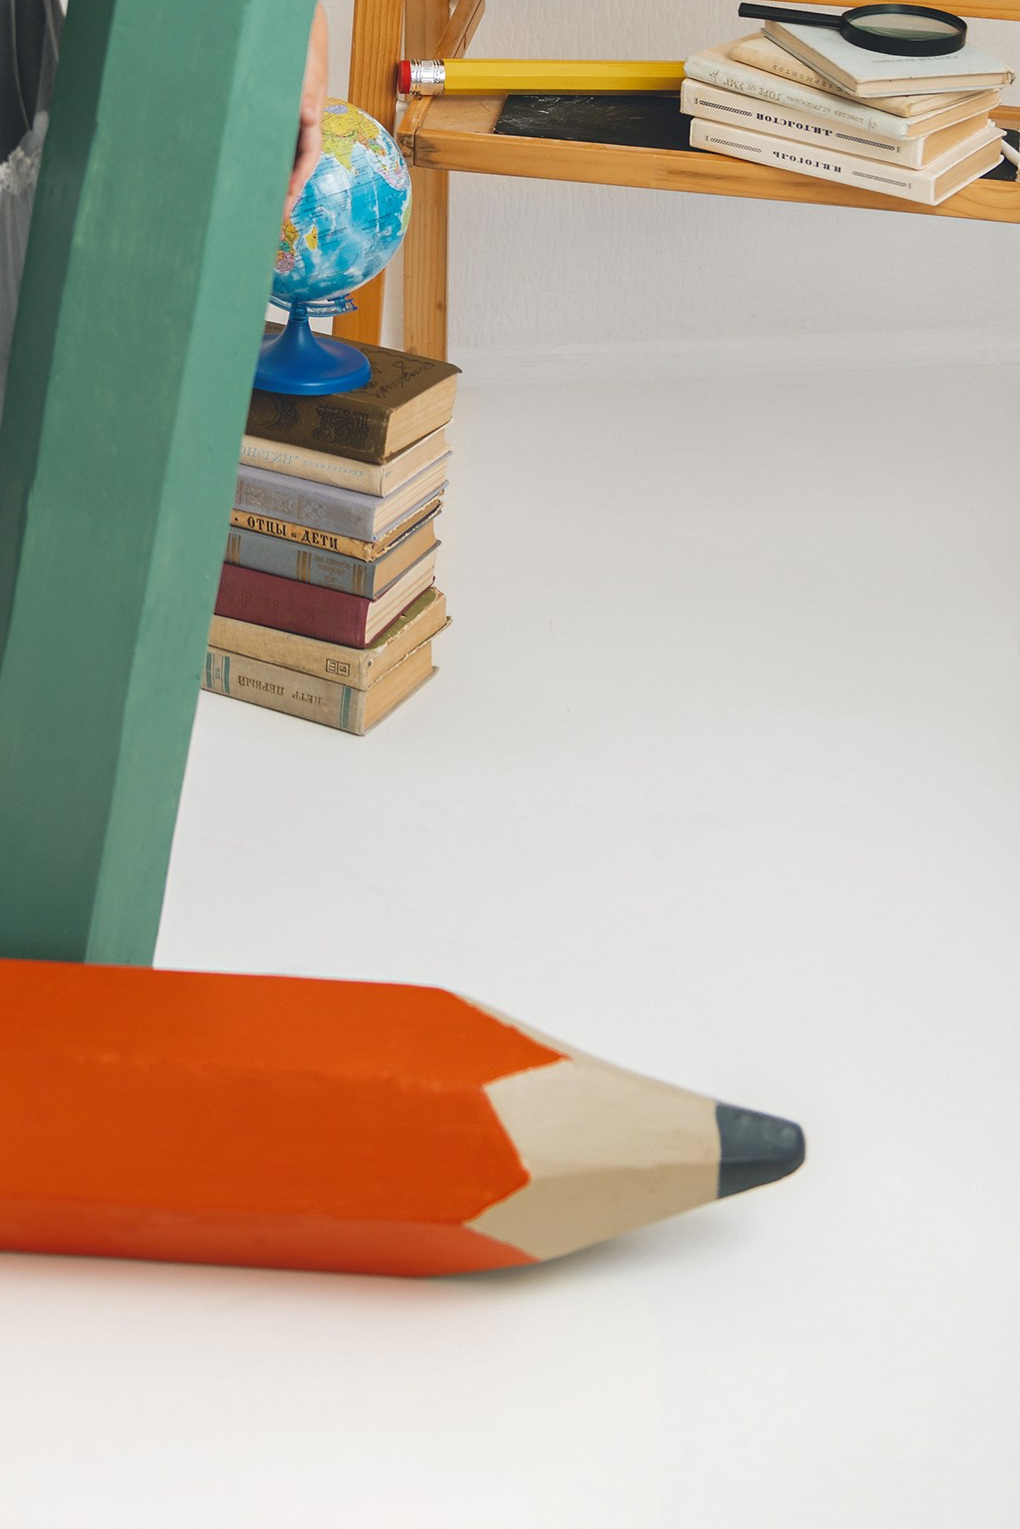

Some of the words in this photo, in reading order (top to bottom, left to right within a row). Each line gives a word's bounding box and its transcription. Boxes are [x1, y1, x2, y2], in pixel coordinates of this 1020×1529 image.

[247, 516, 287, 537] ОТЦЫ
[301, 530, 339, 550] ДЕТИ
[237, 675, 284, 696] ПЕРВЫЙ
[292, 691, 322, 705] ПЕТР
